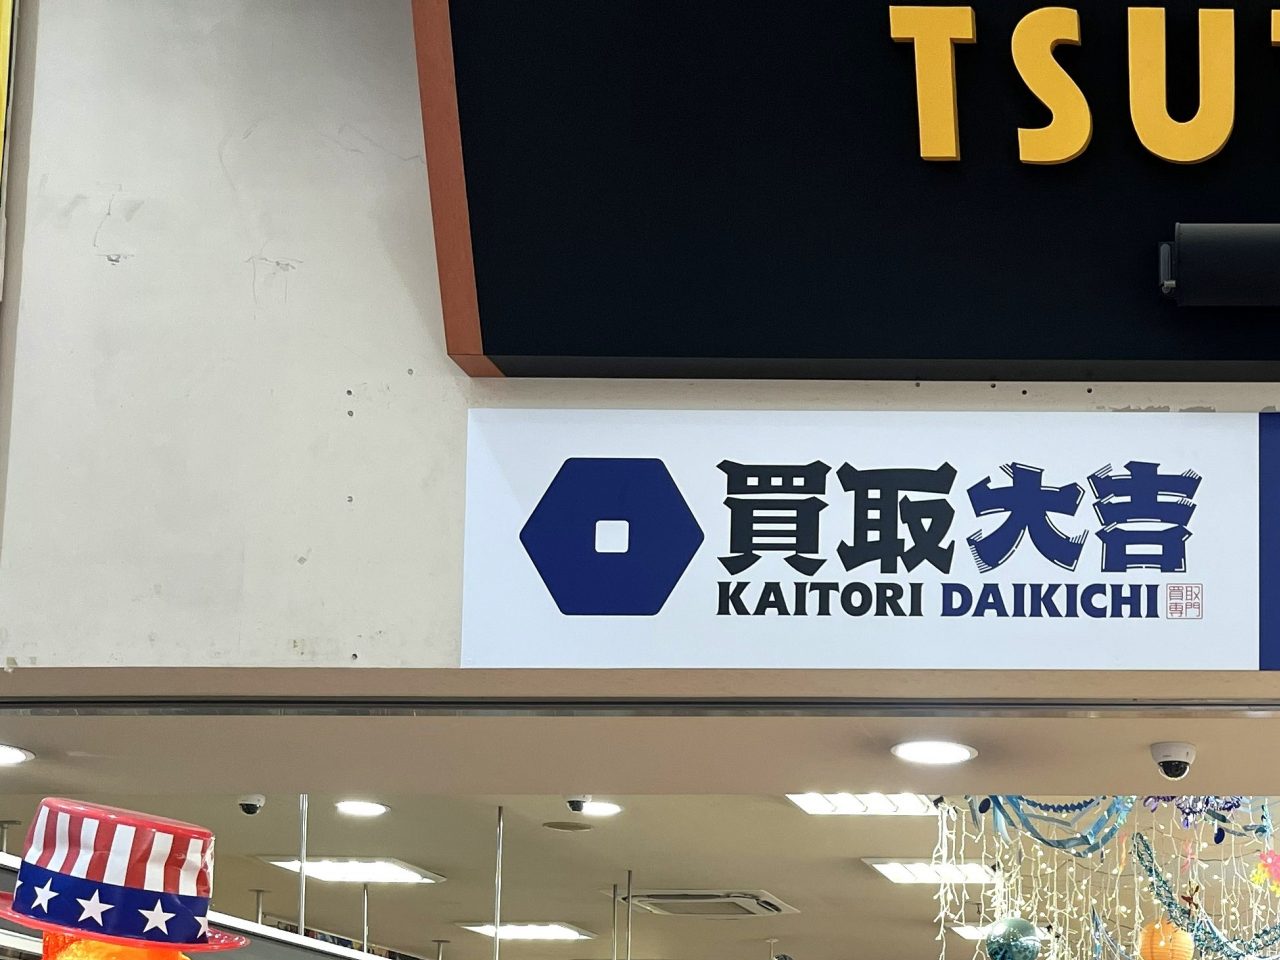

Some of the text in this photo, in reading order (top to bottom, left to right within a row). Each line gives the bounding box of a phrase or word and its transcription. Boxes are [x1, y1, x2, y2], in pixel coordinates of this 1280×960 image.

[716, 459, 1201, 574] 買取大吉
[716, 582, 1160, 618] KAITORI DAIKICHI
